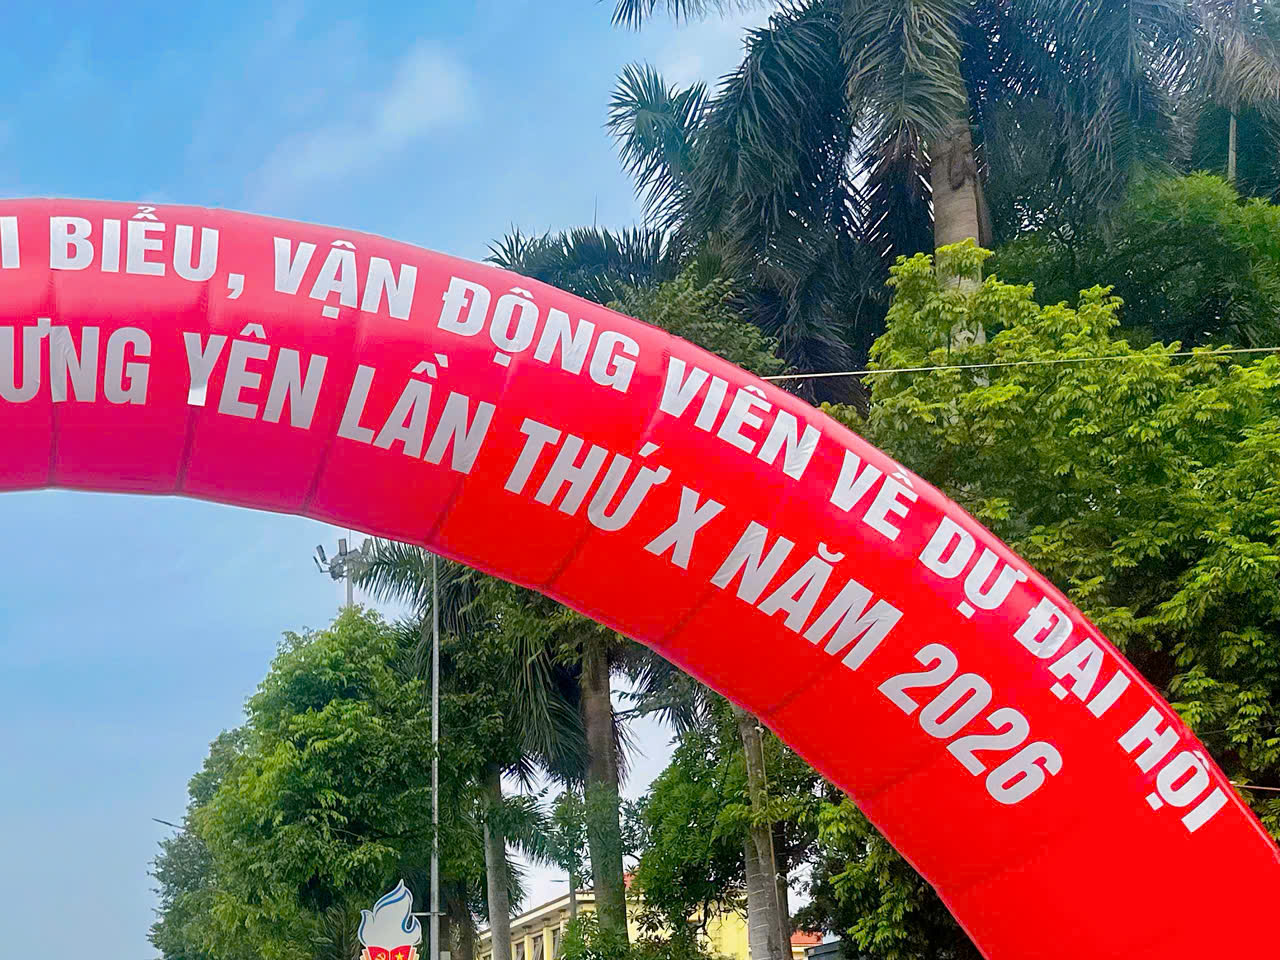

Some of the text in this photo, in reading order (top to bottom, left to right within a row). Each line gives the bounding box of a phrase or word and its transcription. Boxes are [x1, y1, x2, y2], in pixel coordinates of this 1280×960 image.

[50, 205, 244, 299] BIỂU,
[274, 237, 417, 320] VẬN
[437, 276, 639, 392] ĐỘNG
[659, 356, 821, 480] VIÊN
[830, 448, 918, 541] VỀ
[919, 516, 1027, 618] DỰ
[1014, 597, 1130, 717] ĐẠI
[1118, 707, 1228, 833] HỘI
[184, 323, 327, 428] YÊN
[338, 352, 495, 473] LẦN
[505, 418, 670, 530] THỨ
[645, 487, 724, 568] X
[711, 521, 903, 670] NĂM
[878, 644, 1062, 803] 2026
